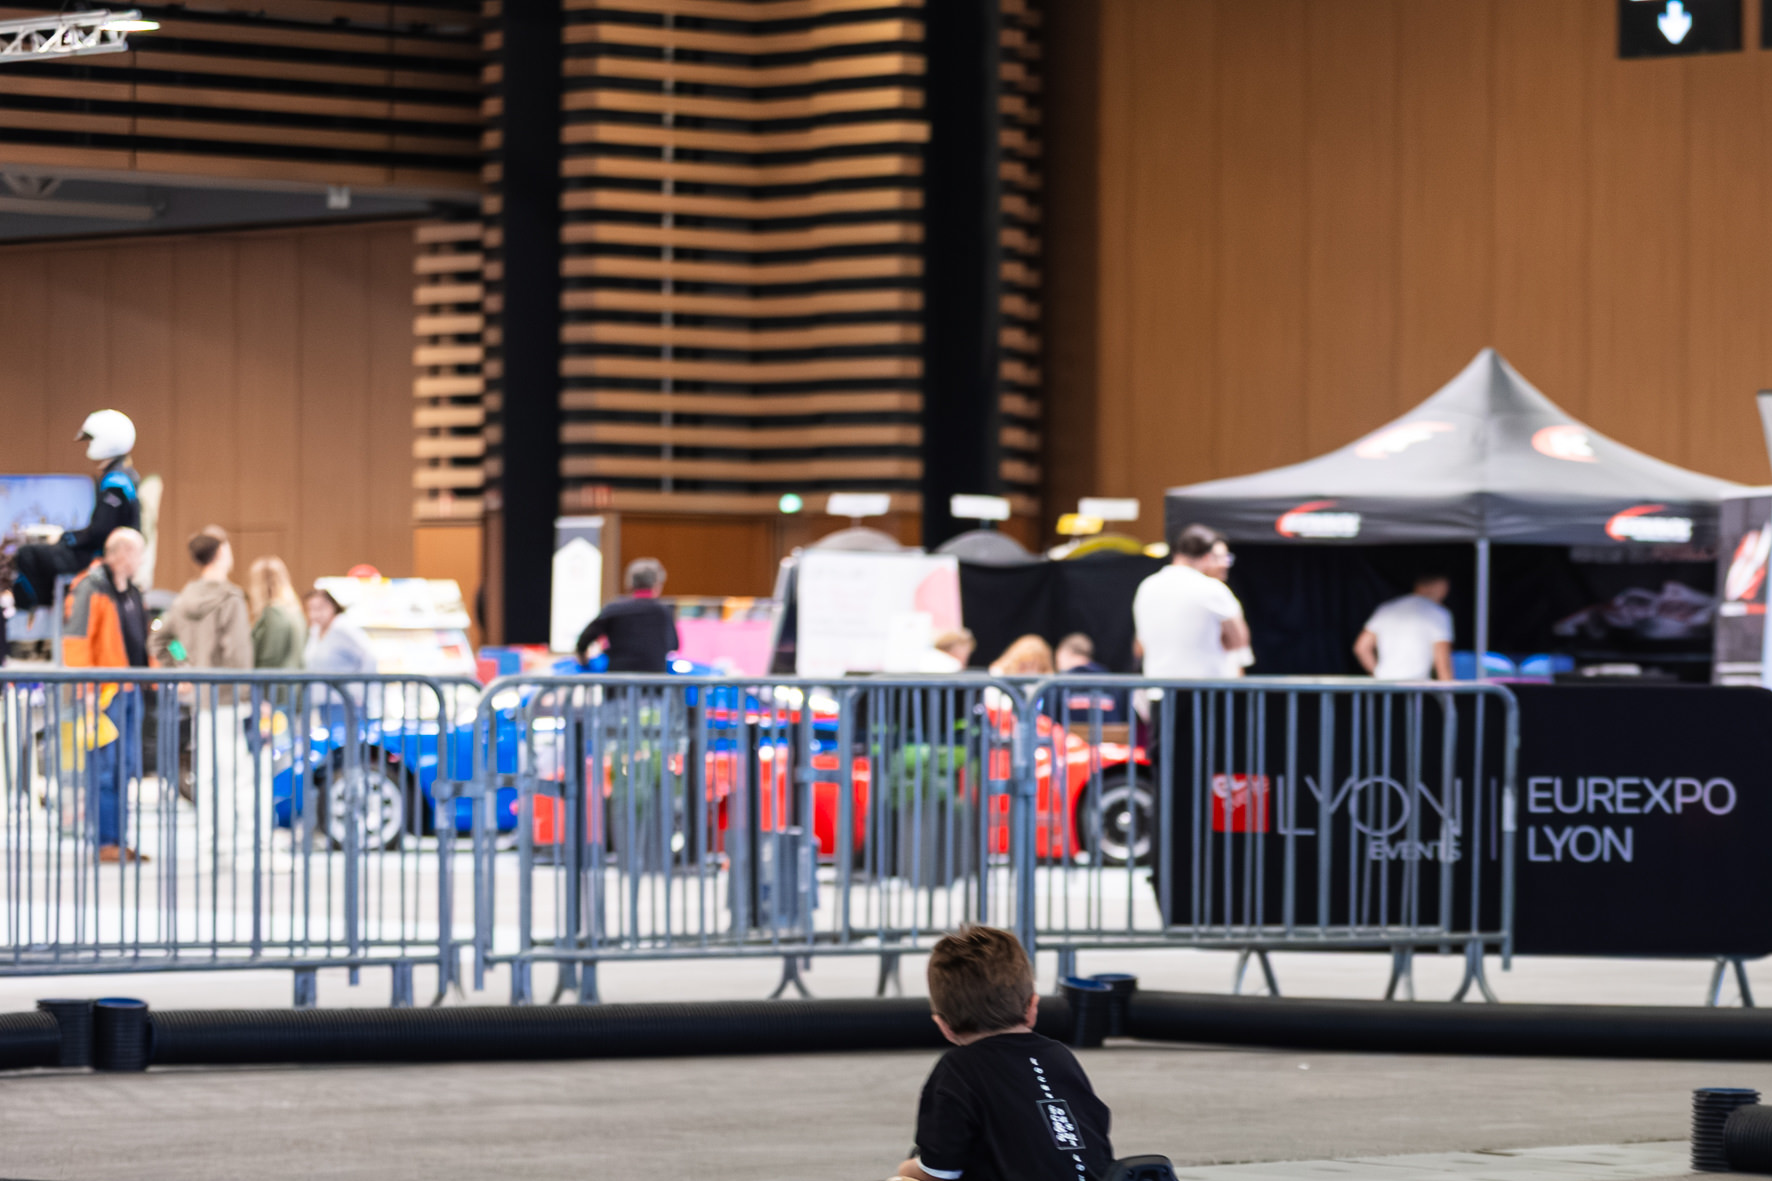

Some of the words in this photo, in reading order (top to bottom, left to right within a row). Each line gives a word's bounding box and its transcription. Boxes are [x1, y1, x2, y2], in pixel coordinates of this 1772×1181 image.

[1277, 774, 1463, 838] LYON
[1528, 777, 1737, 815] EUREXPO
[1528, 826, 1633, 863] LYON
